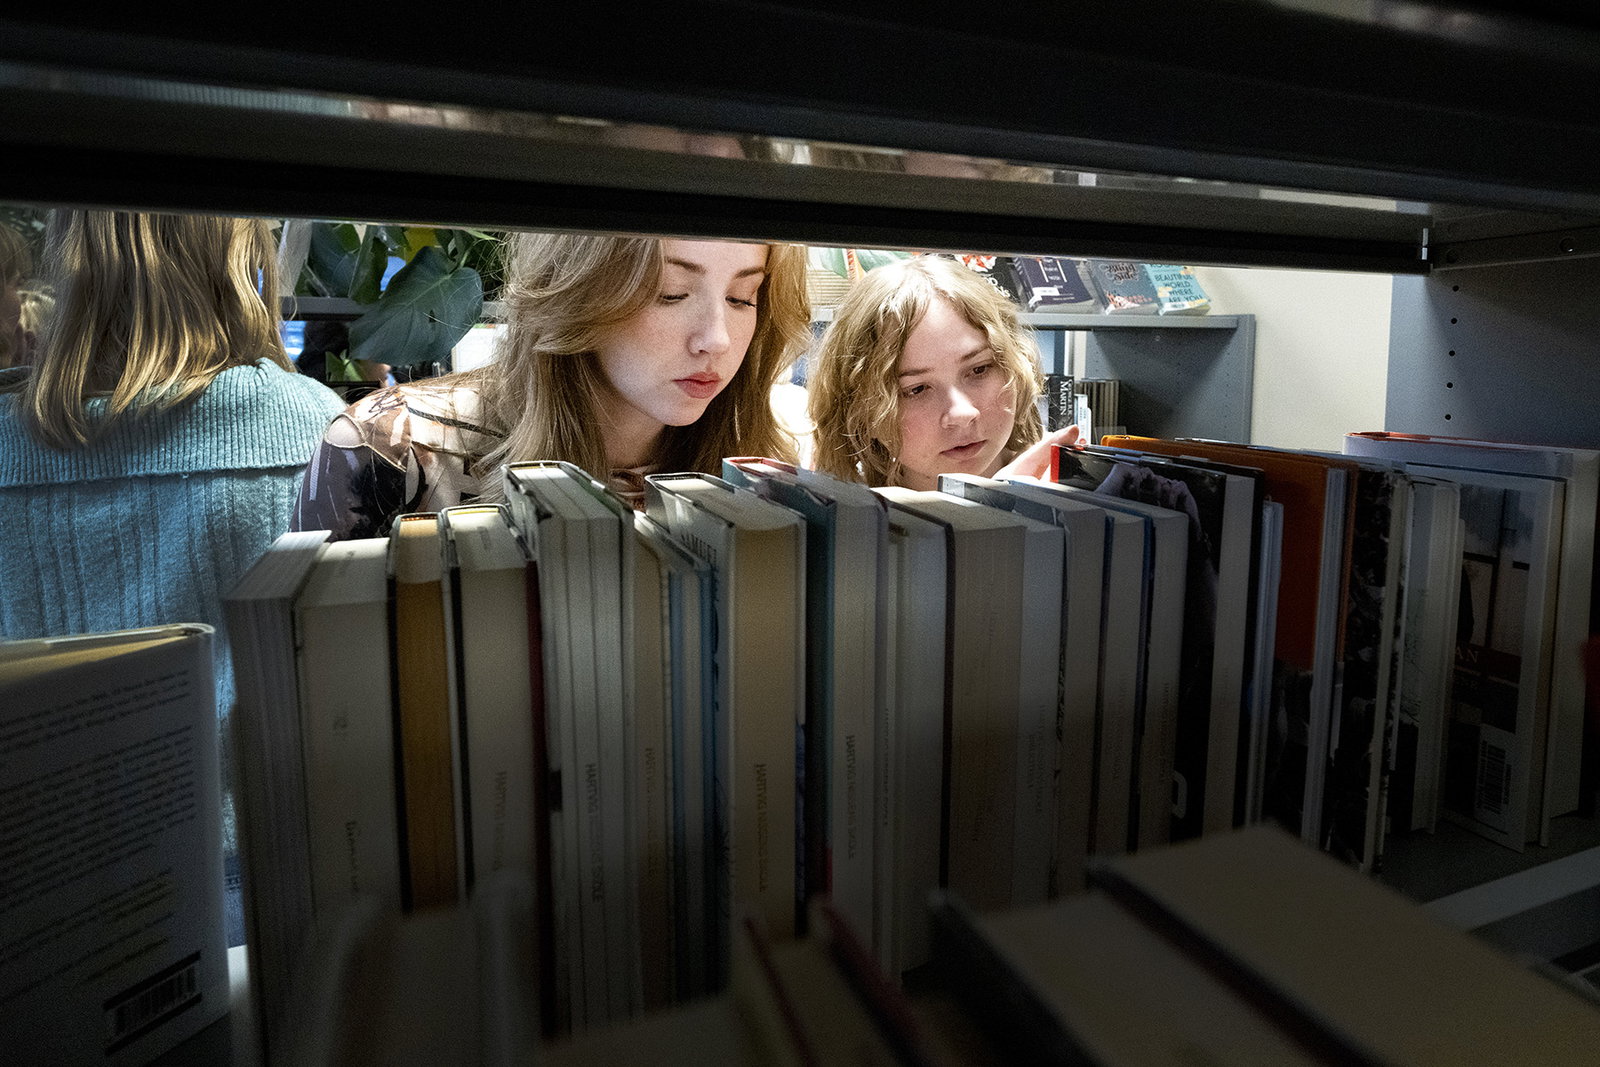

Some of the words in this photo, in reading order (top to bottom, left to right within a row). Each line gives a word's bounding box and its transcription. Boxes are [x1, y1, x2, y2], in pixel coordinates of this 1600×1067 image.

[1154, 273, 1193, 281] BEAUTIFUL
[1060, 381, 1069, 415] MARTIN
[845, 734, 856, 780] HARTVIG
[586, 763, 598, 813] HARTVIG
[754, 763, 768, 810] HARTVIG
